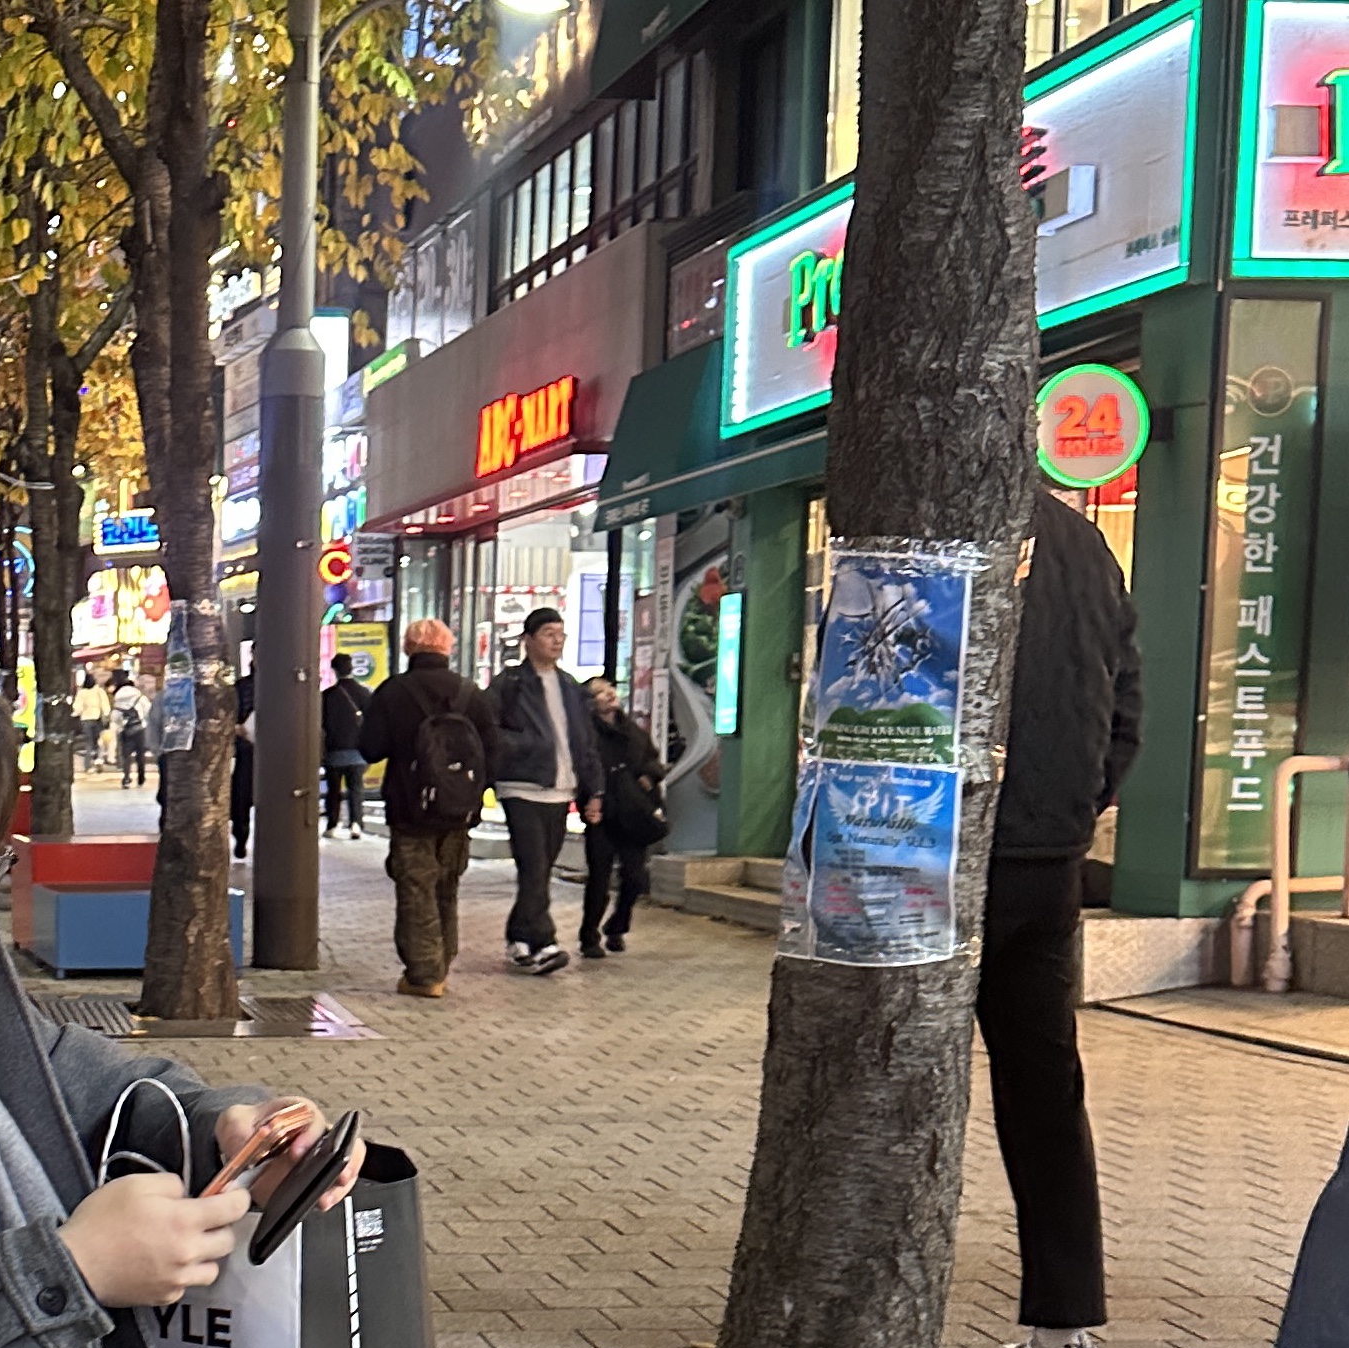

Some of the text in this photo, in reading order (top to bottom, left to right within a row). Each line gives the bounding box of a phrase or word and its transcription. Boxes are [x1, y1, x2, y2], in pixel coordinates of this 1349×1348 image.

[1054, 393, 1123, 438] 24
[1226, 433, 1283, 812] 건강한 패스트푸드
